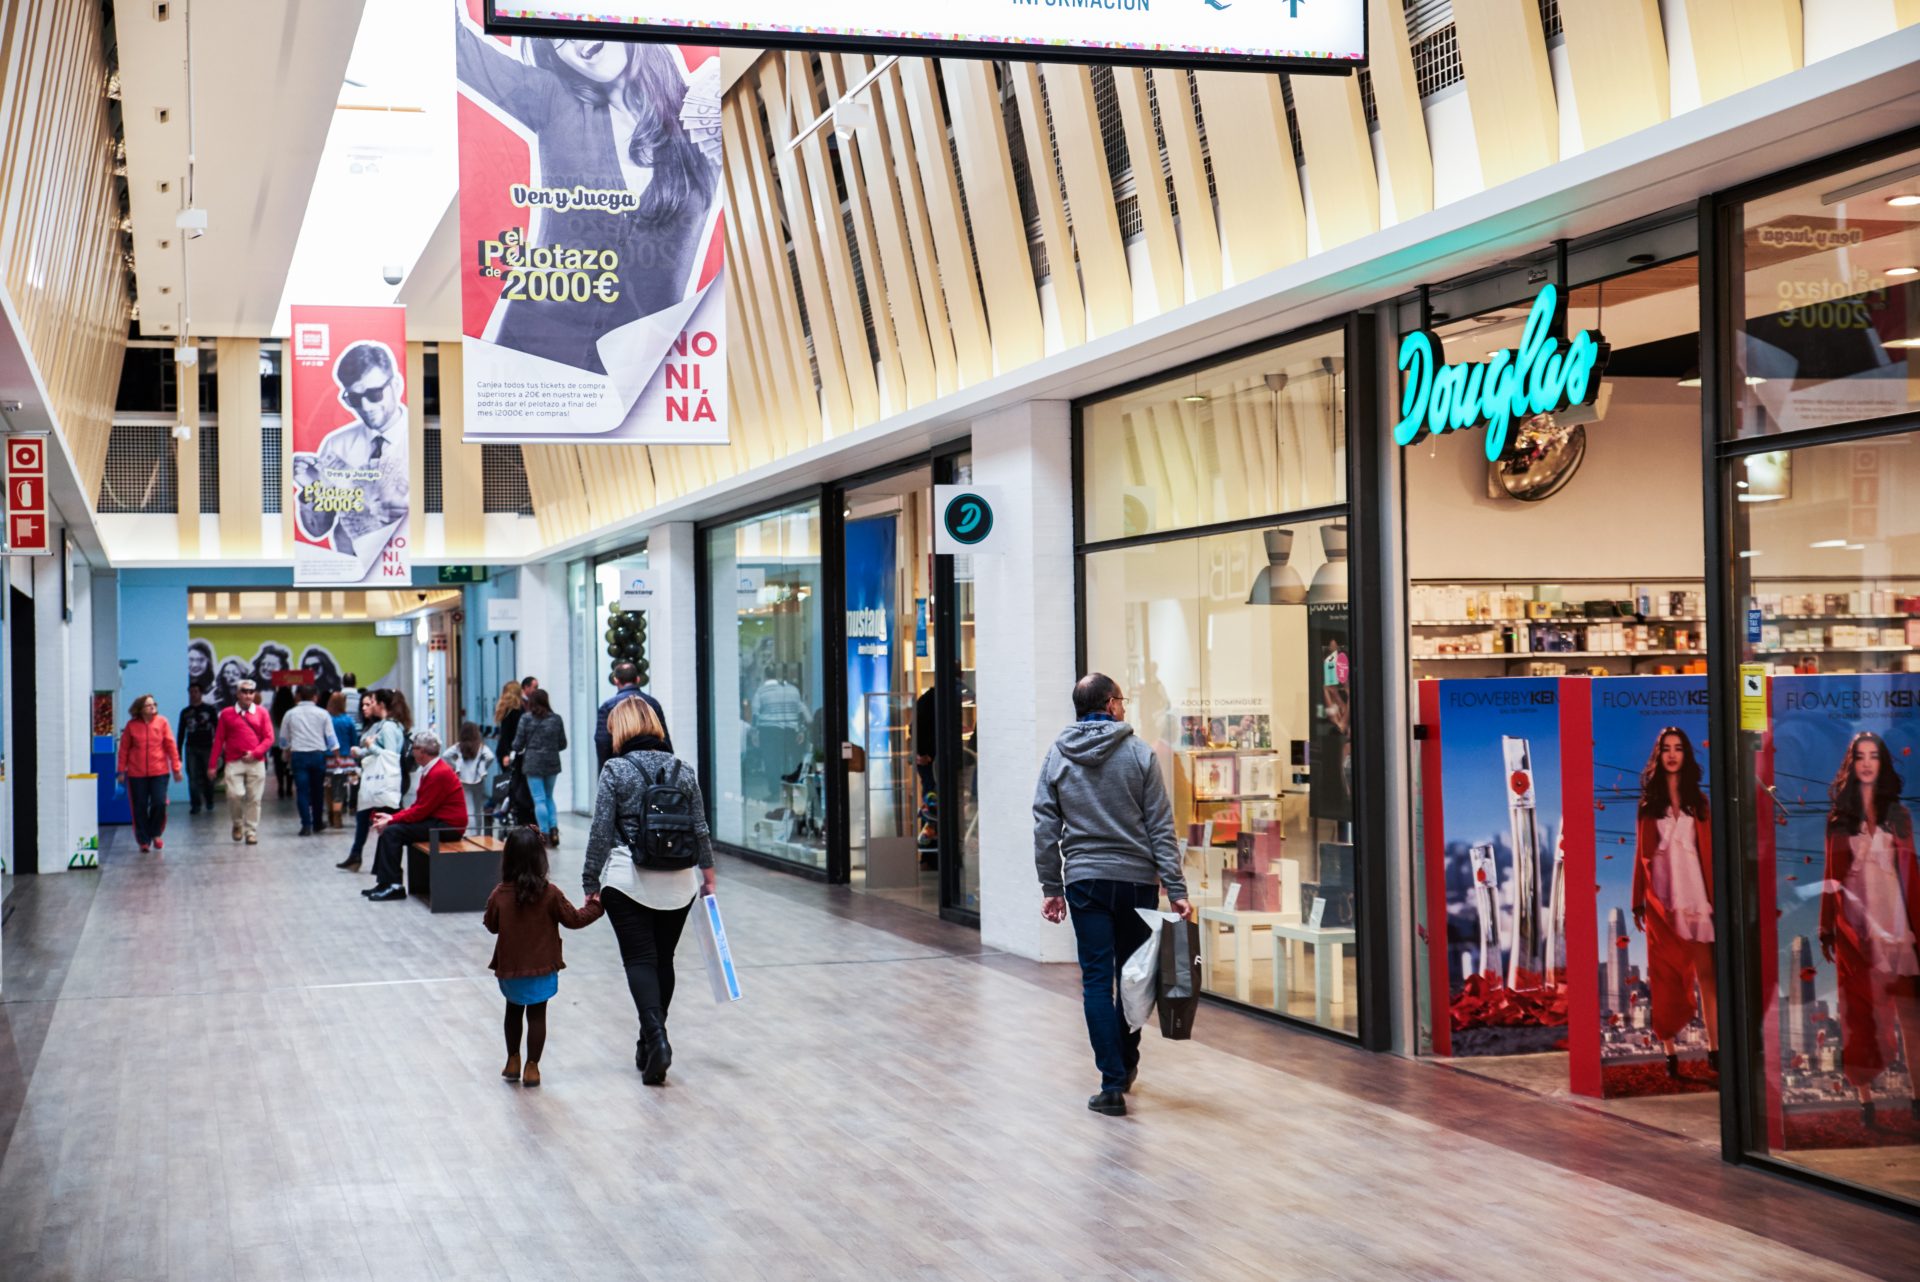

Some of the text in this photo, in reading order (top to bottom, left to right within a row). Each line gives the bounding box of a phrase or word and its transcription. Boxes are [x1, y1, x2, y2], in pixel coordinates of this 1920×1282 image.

[512, 187, 637, 210] Ven y Juega
[502, 227, 524, 246] el
[481, 240, 619, 270] Pelotazo
[481, 266, 620, 303] de 2000€
[665, 331, 718, 357] NO
[665, 363, 701, 390] NI
[1393, 283, 1599, 462] Douglas
[477, 381, 502, 389] Canjea
[504, 381, 524, 389] todos
[527, 381, 539, 389] tus
[541, 381, 566, 389] tickets
[477, 391, 516, 399] superiores
[583, 391, 598, 399] web
[477, 400, 503, 408] podrás
[528, 400, 560, 408] pelotazo
[568, 400, 584, 408] final
[586, 400, 597, 408] del
[536, 410, 570, 418] compras!
[666, 389, 718, 422] NÁ
[313, 497, 365, 512] 2000€
[383, 551, 399, 562] NI
